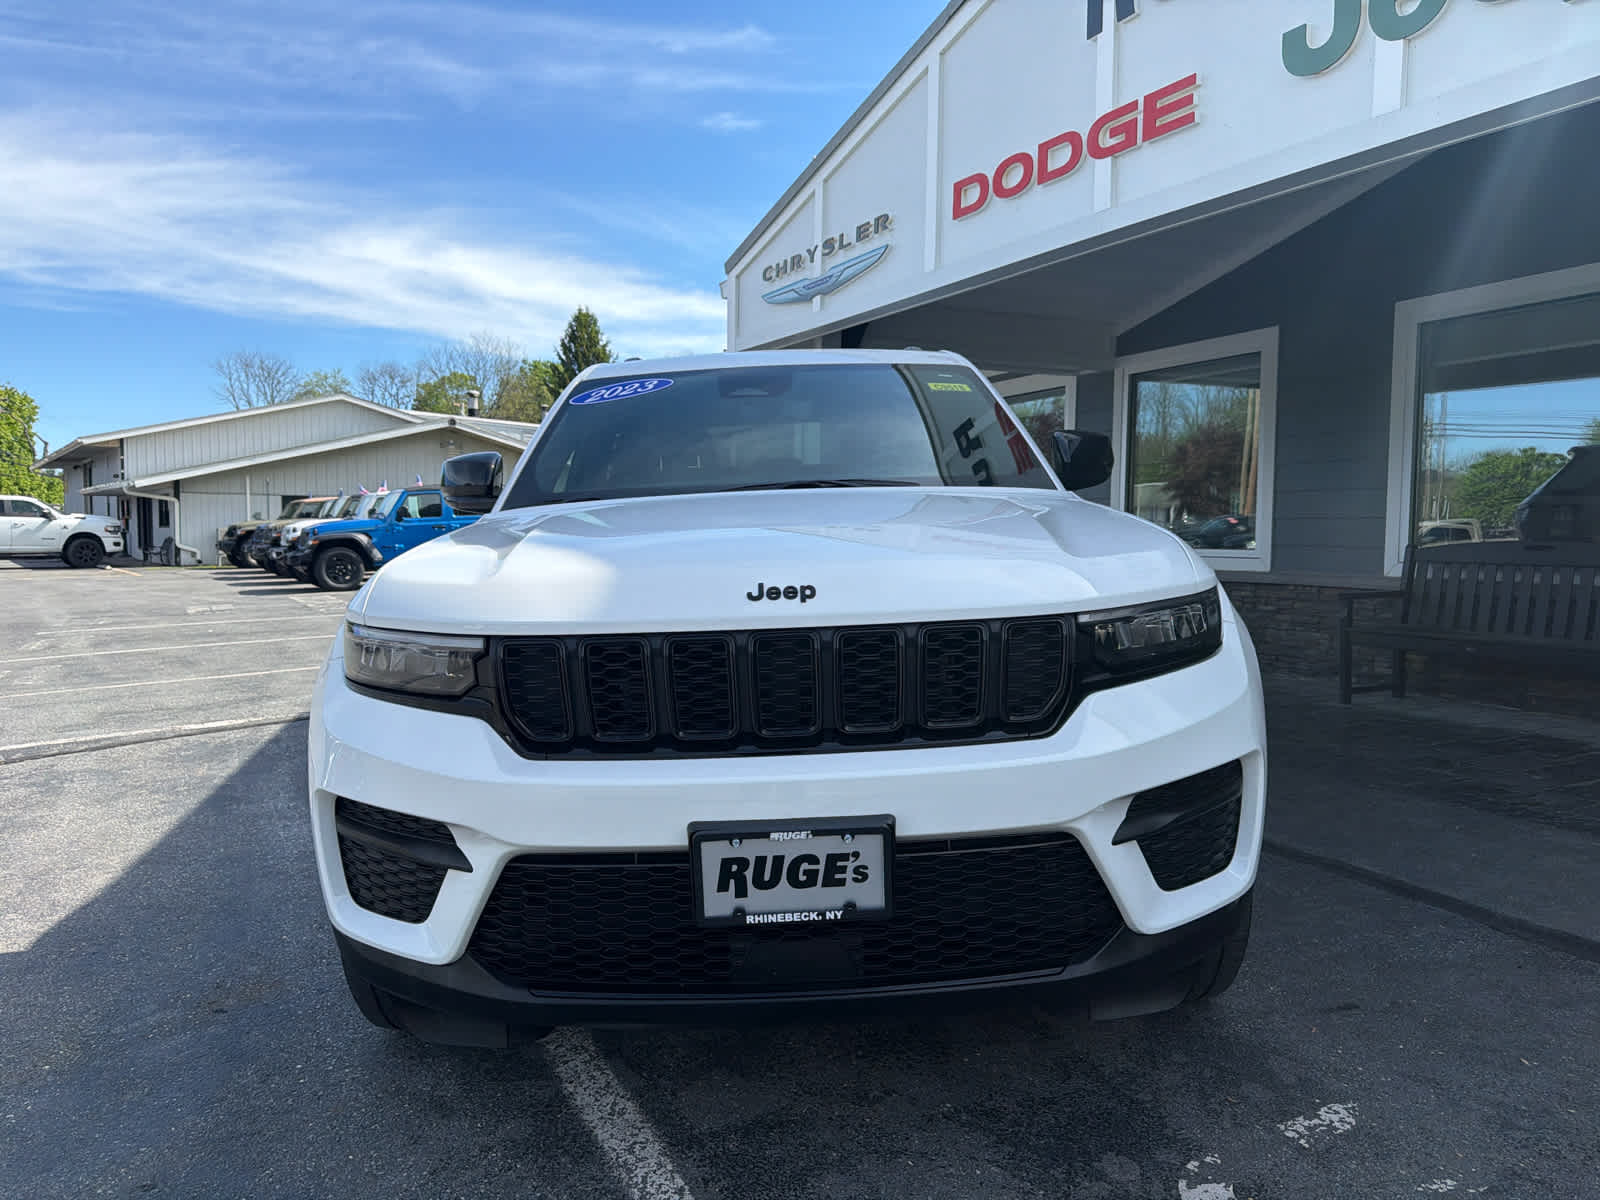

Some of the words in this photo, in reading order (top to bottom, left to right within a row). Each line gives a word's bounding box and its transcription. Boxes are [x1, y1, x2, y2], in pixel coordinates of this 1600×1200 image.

[952, 72, 1198, 221] DODGE
[763, 213, 891, 282] CHRYSLER
[583, 379, 660, 403] 2023
[746, 581, 817, 604] Jeep
[716, 850, 869, 899] RUGE's
[825, 910, 844, 920] NY
